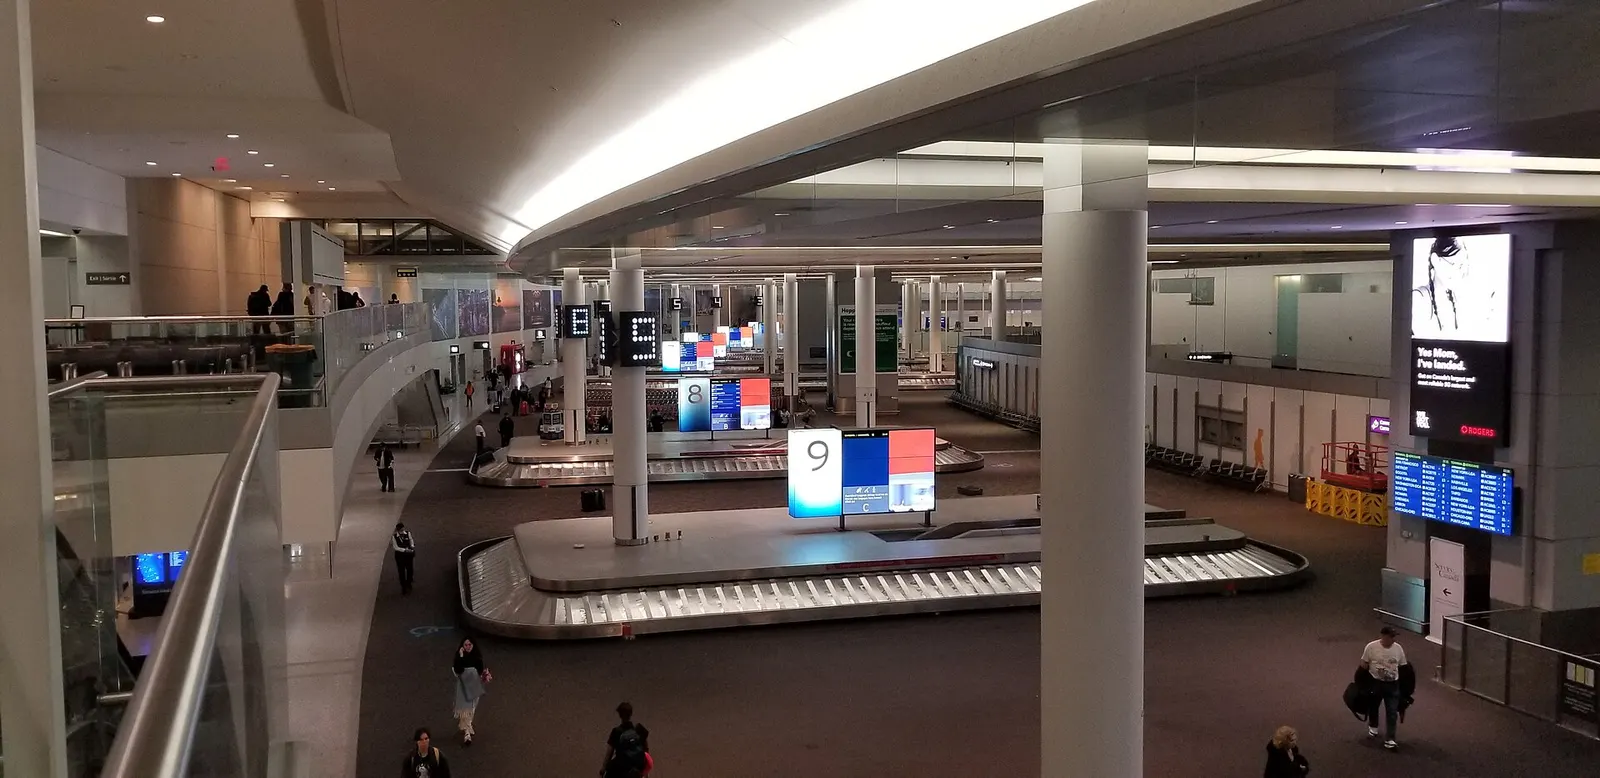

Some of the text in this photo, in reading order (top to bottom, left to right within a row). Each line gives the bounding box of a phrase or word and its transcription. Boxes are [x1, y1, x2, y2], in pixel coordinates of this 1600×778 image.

[673, 299, 681, 310] 5
[715, 297, 721, 307] 4
[632, 317, 656, 360] 9
[1417, 347, 1459, 360] Yes Mom,
[1417, 358, 1466, 371] I've landed.
[688, 384, 702, 403] 8
[1469, 427, 1494, 437] ROGERS
[808, 440, 829, 471] 9
[863, 503, 869, 512] C
[1438, 570, 1459, 582] Canada
